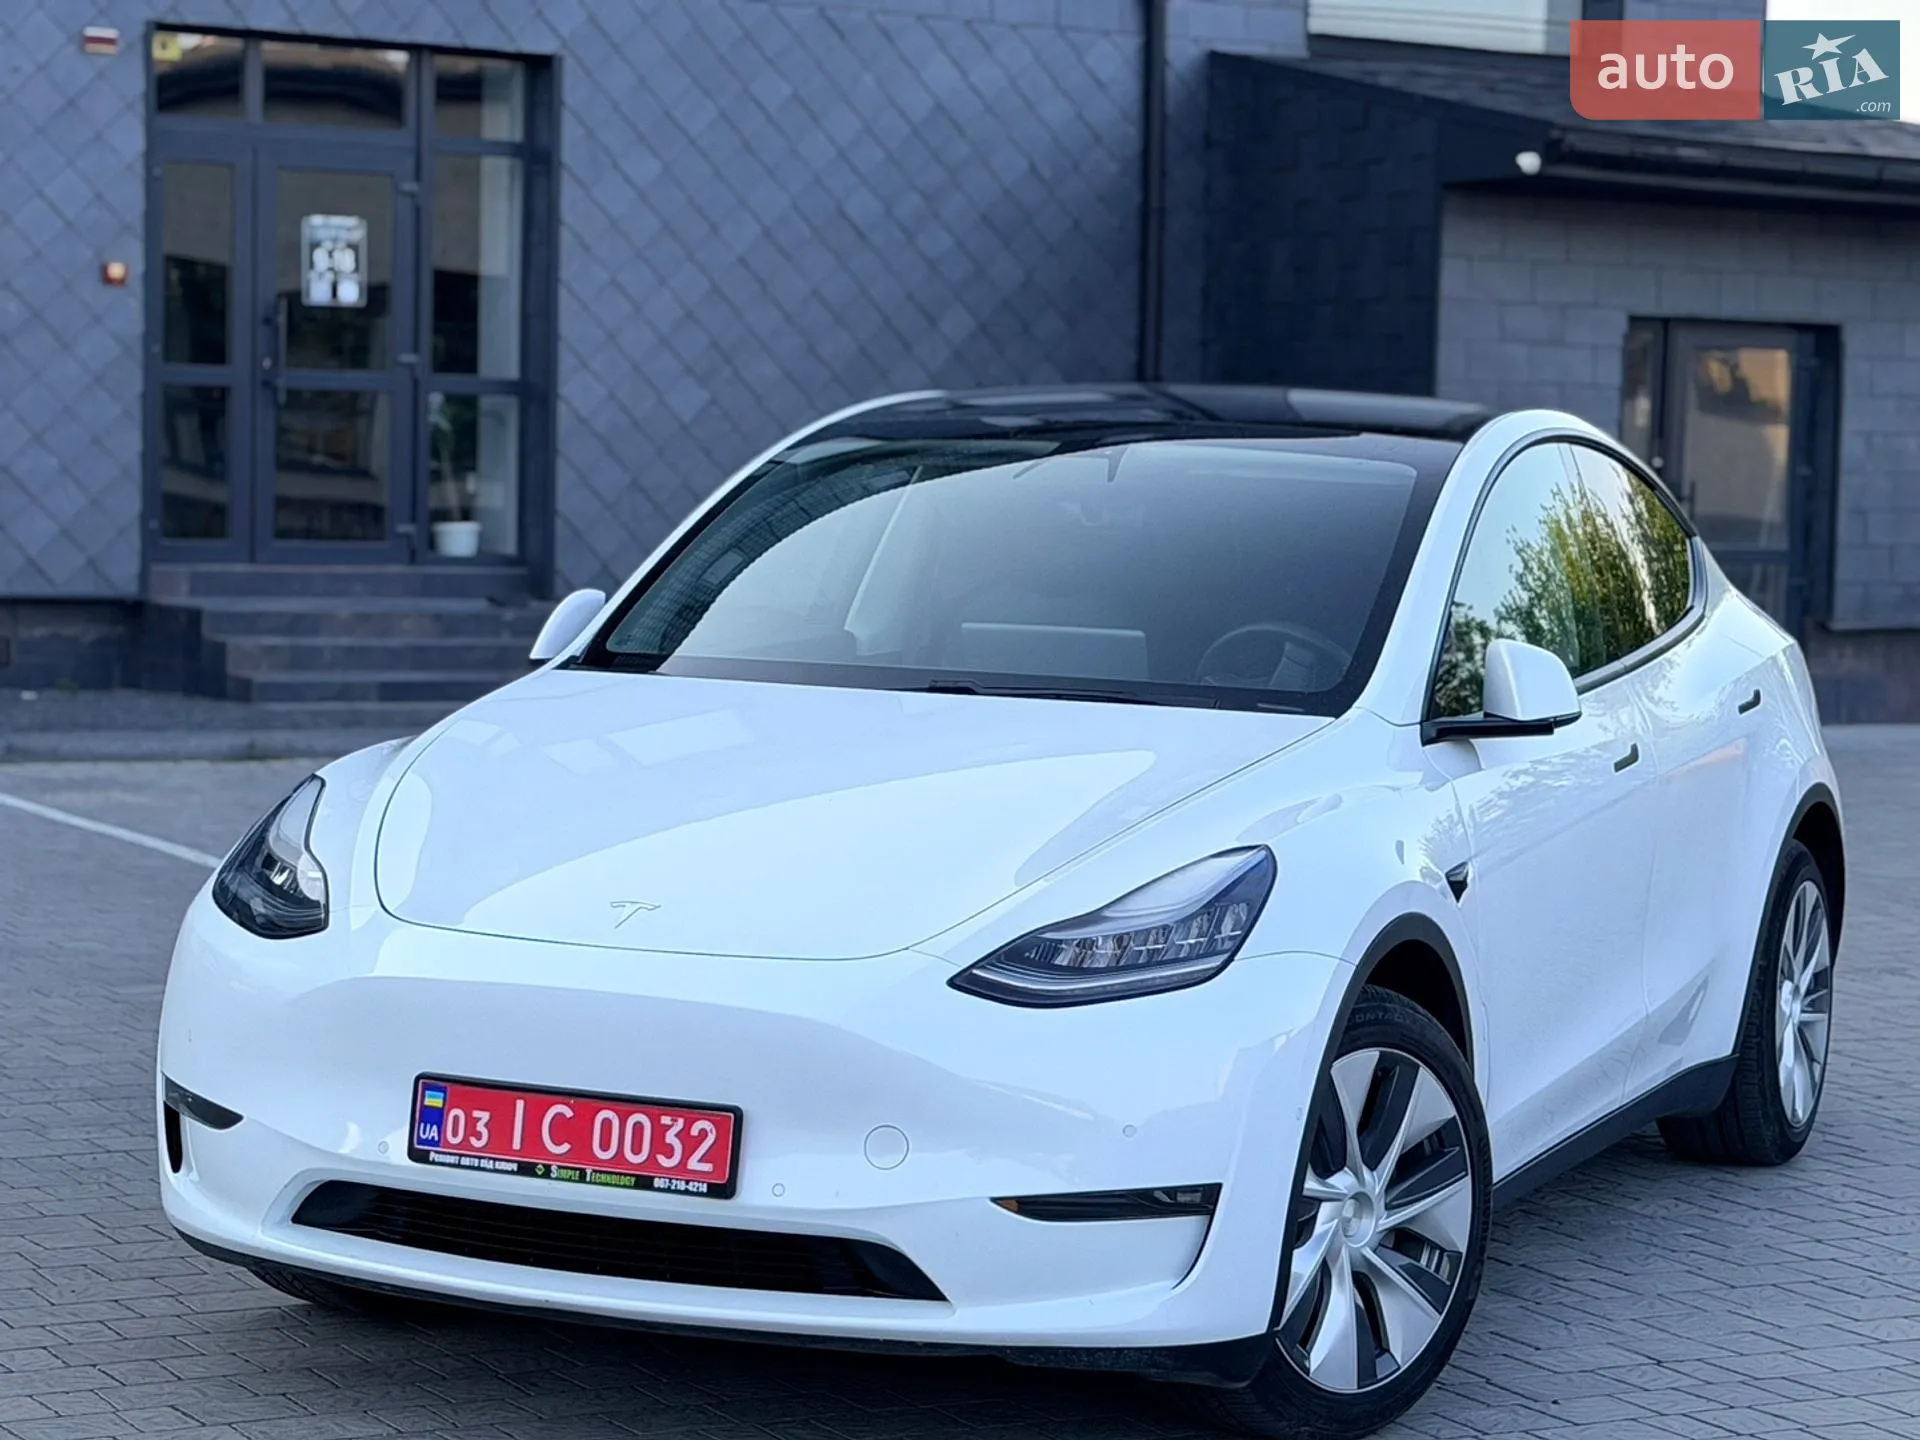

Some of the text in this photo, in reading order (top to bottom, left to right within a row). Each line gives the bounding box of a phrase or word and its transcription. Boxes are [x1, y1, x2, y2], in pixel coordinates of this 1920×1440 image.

[419, 1122, 439, 1142] UA
[446, 1108, 490, 1149] 03
[592, 1109, 718, 1173] 0032
